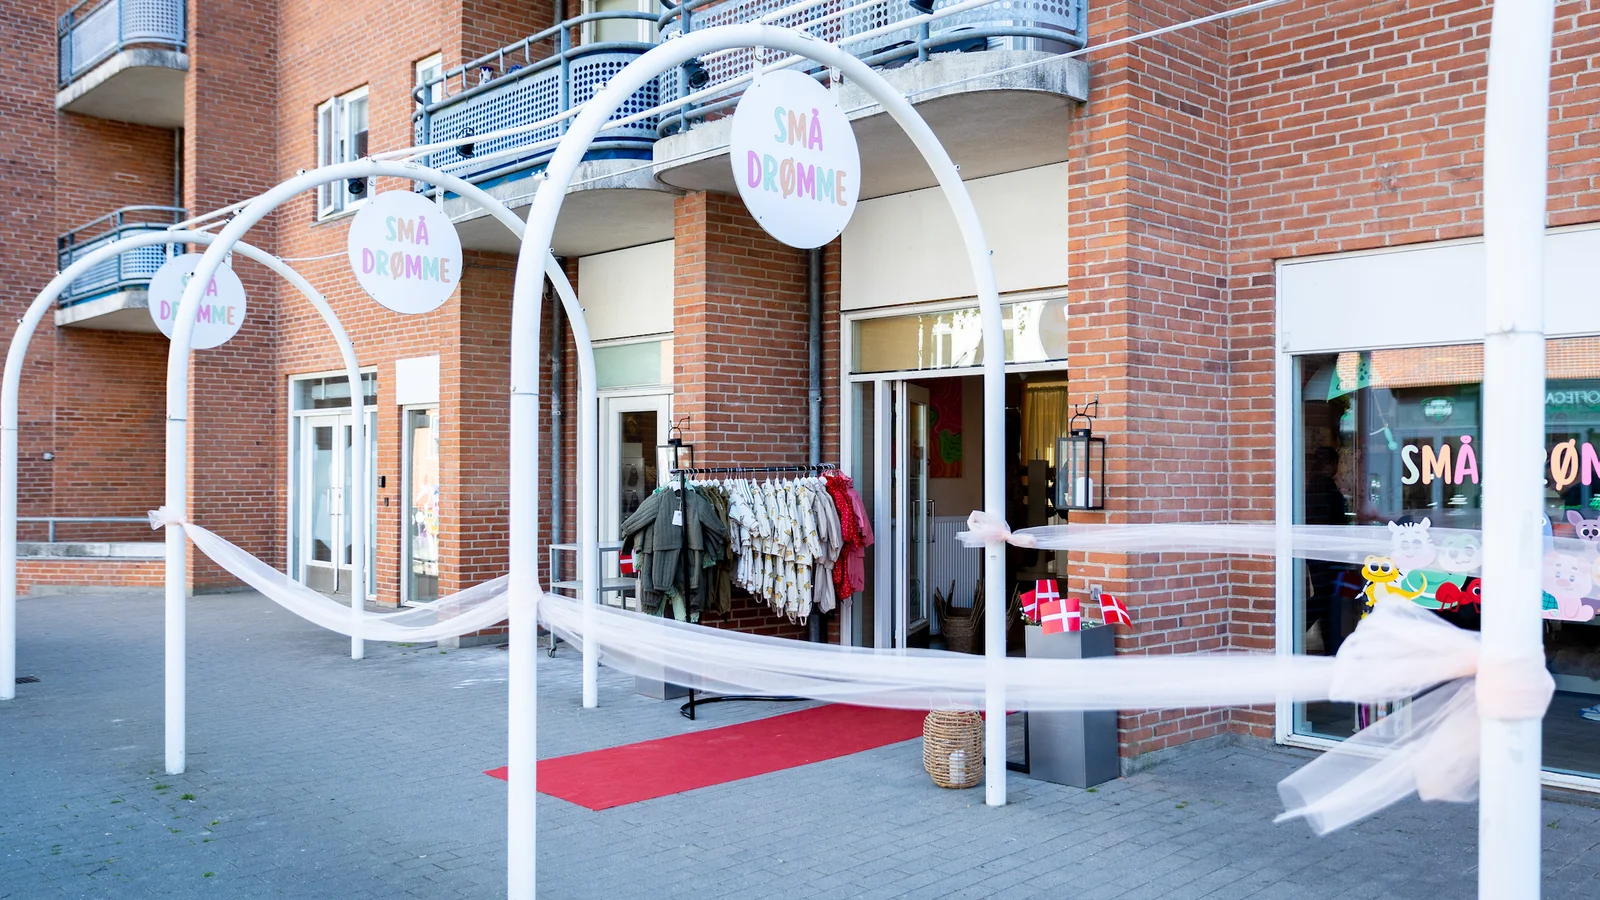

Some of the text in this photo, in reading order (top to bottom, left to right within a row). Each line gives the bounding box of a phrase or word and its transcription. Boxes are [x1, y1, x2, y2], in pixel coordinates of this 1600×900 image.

[774, 106, 823, 151] SMÅ
[747, 150, 847, 207] DRØMME
[385, 215, 429, 245] SMÅ
[362, 247, 451, 283] DRØMME
[181, 274, 218, 297] SÅ
[160, 299, 236, 325] DMME
[1401, 434, 1479, 485] SMÅ
